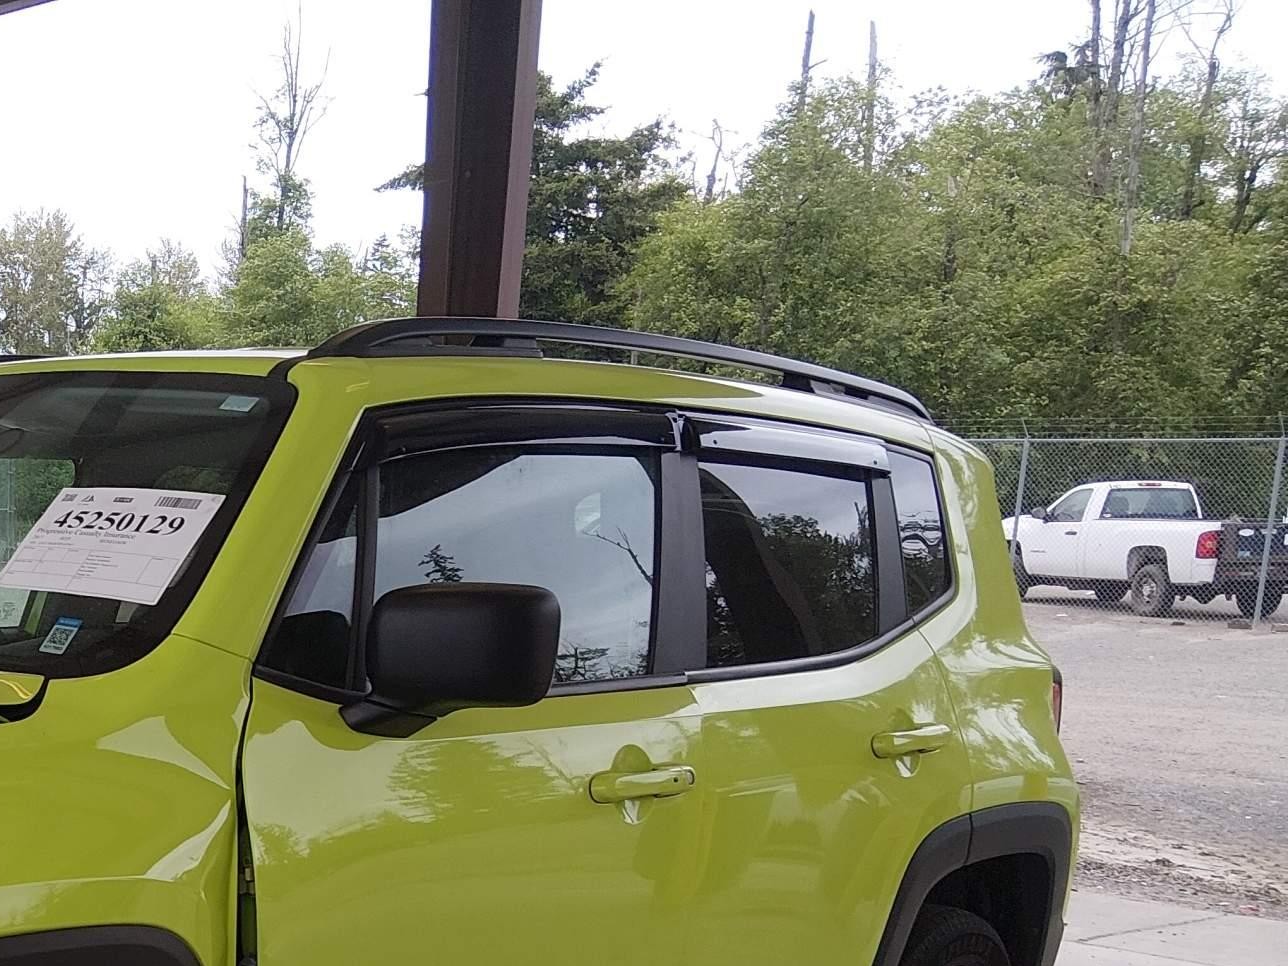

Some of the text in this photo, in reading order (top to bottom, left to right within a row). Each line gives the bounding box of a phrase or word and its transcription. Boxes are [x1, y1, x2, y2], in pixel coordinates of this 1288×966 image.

[54, 509, 185, 536] 45250129
[37, 527, 74, 537] Progressive
[74, 529, 102, 539] Casualty
[103, 531, 136, 540] Insurance
